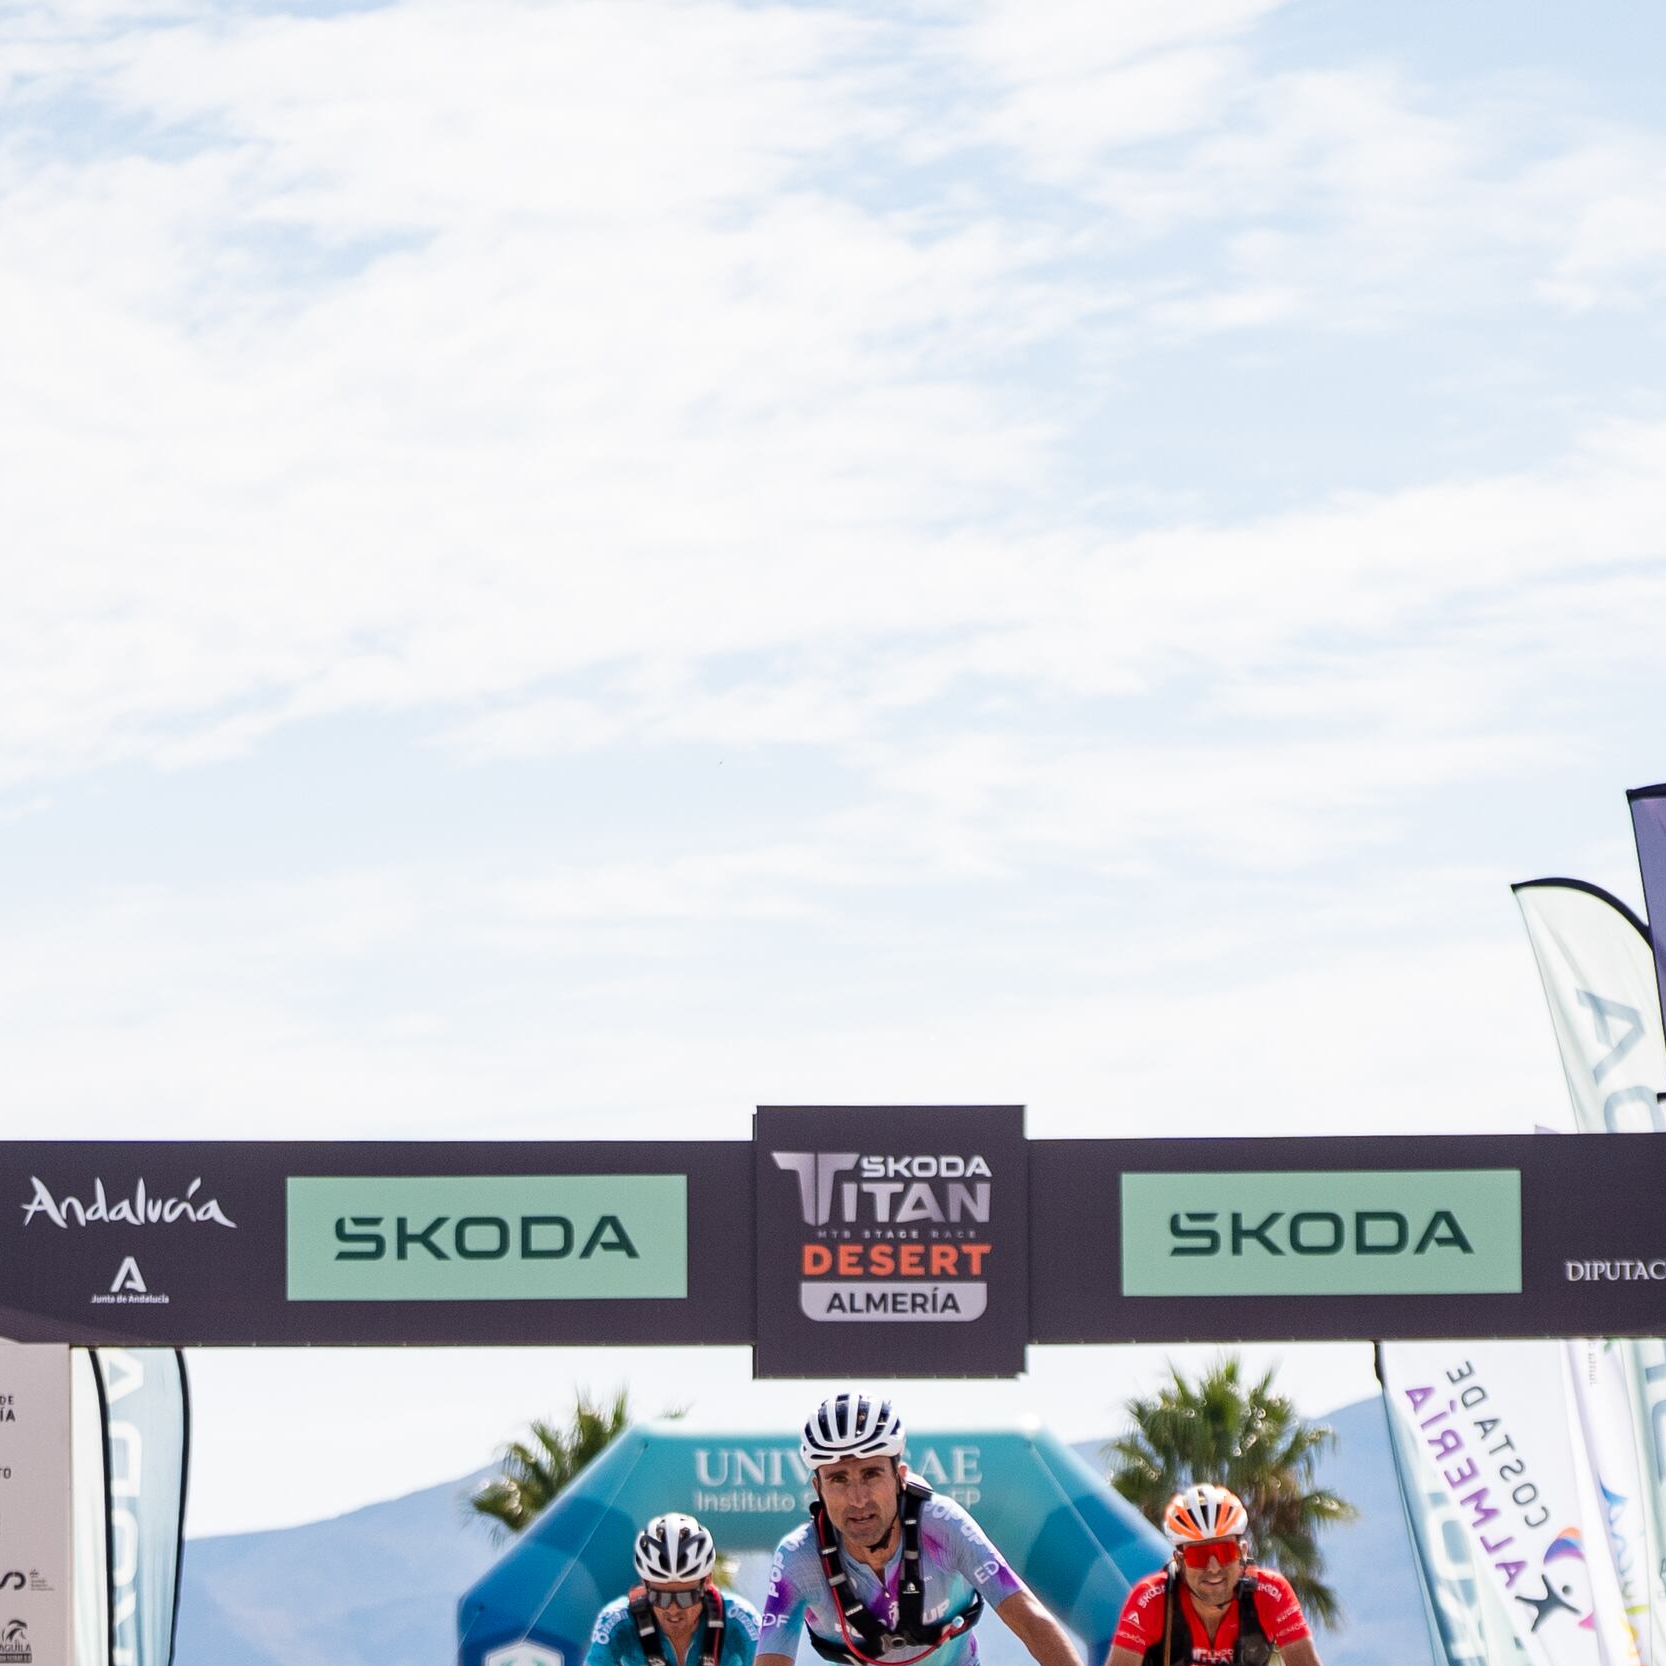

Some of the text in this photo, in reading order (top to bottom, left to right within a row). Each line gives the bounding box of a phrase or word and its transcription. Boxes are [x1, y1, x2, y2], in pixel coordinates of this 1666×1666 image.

[22, 1175, 238, 1229] Andalucía
[771, 1151, 992, 1227] TITAN
[864, 1229, 920, 1239] STAGE
[802, 1244, 993, 1277] DESERT
[826, 1286, 961, 1315] ALMERÍA
[0, 1395, 15, 1404] DE
[695, 1488, 796, 1513] Instituto
